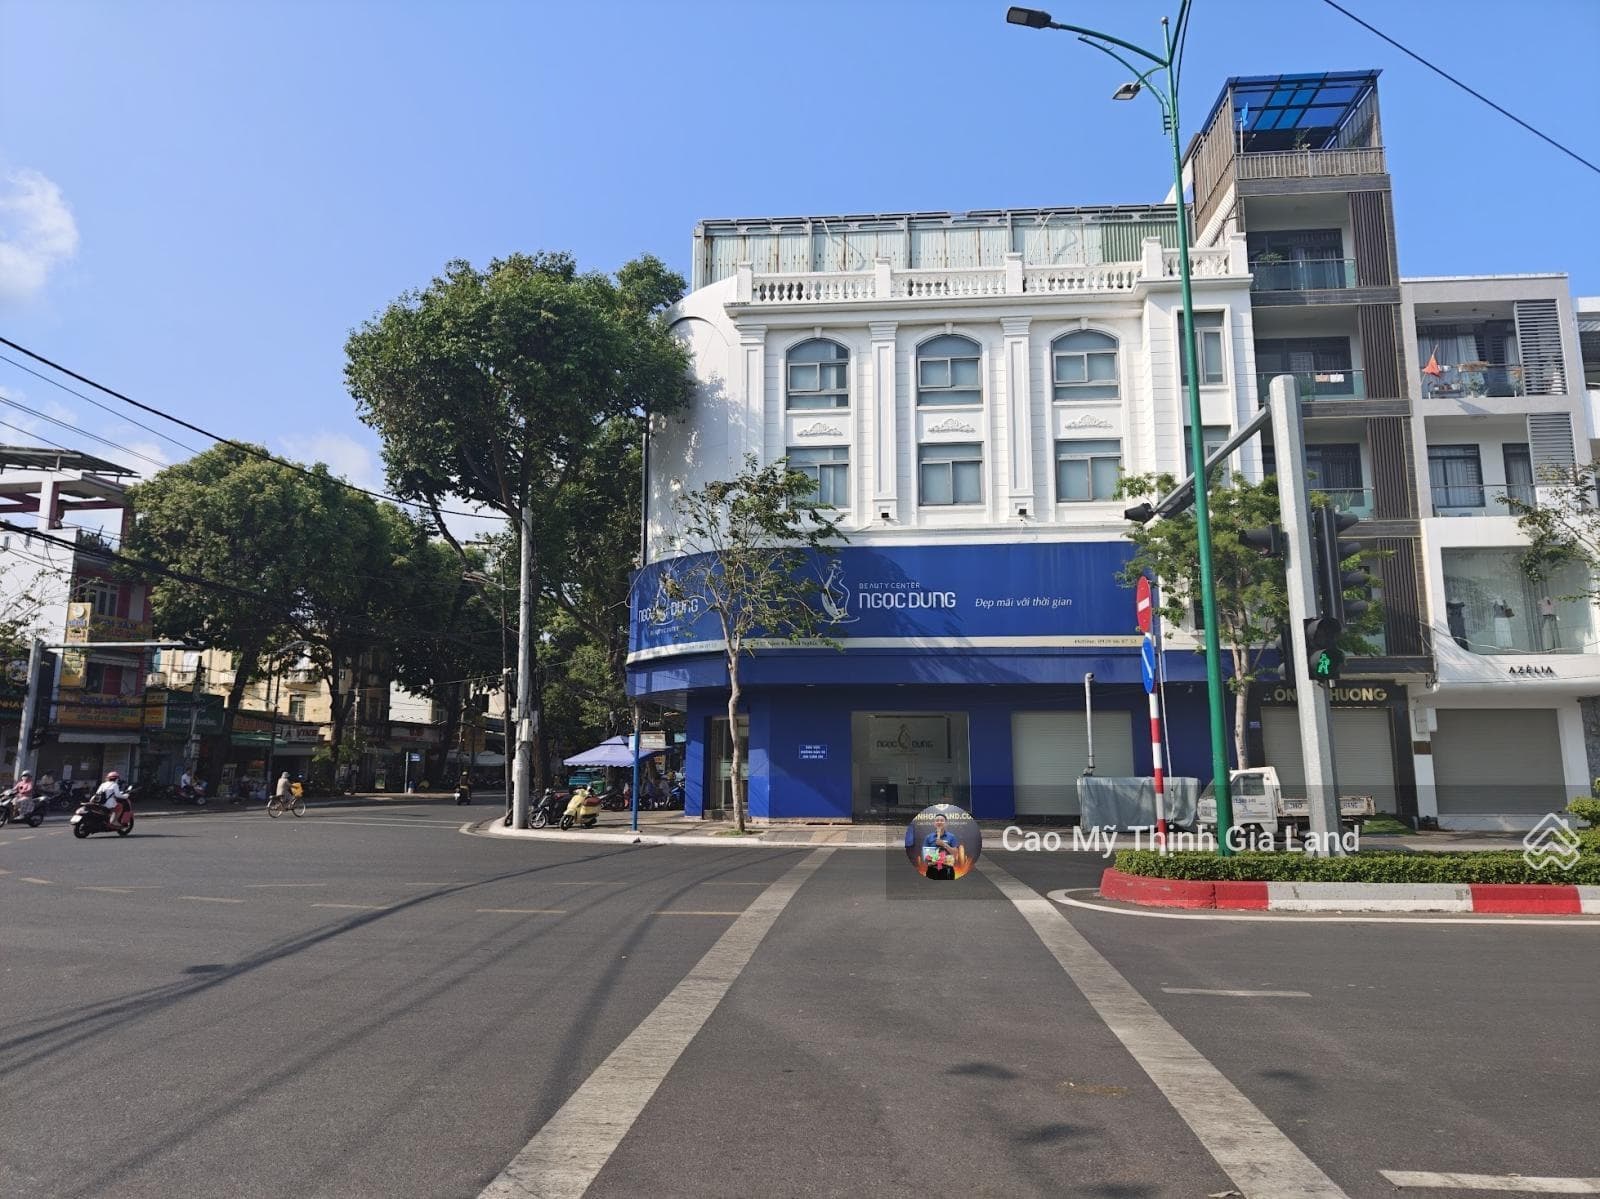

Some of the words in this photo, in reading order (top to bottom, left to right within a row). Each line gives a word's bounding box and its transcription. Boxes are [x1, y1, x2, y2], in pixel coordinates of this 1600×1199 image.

[909, 591, 956, 608] DUNG
[975, 598, 994, 609] Đẹp
[997, 597, 1013, 607] mãi
[1016, 597, 1030, 607] với
[1033, 596, 1049, 606] thời
[1052, 597, 1073, 608] gian
